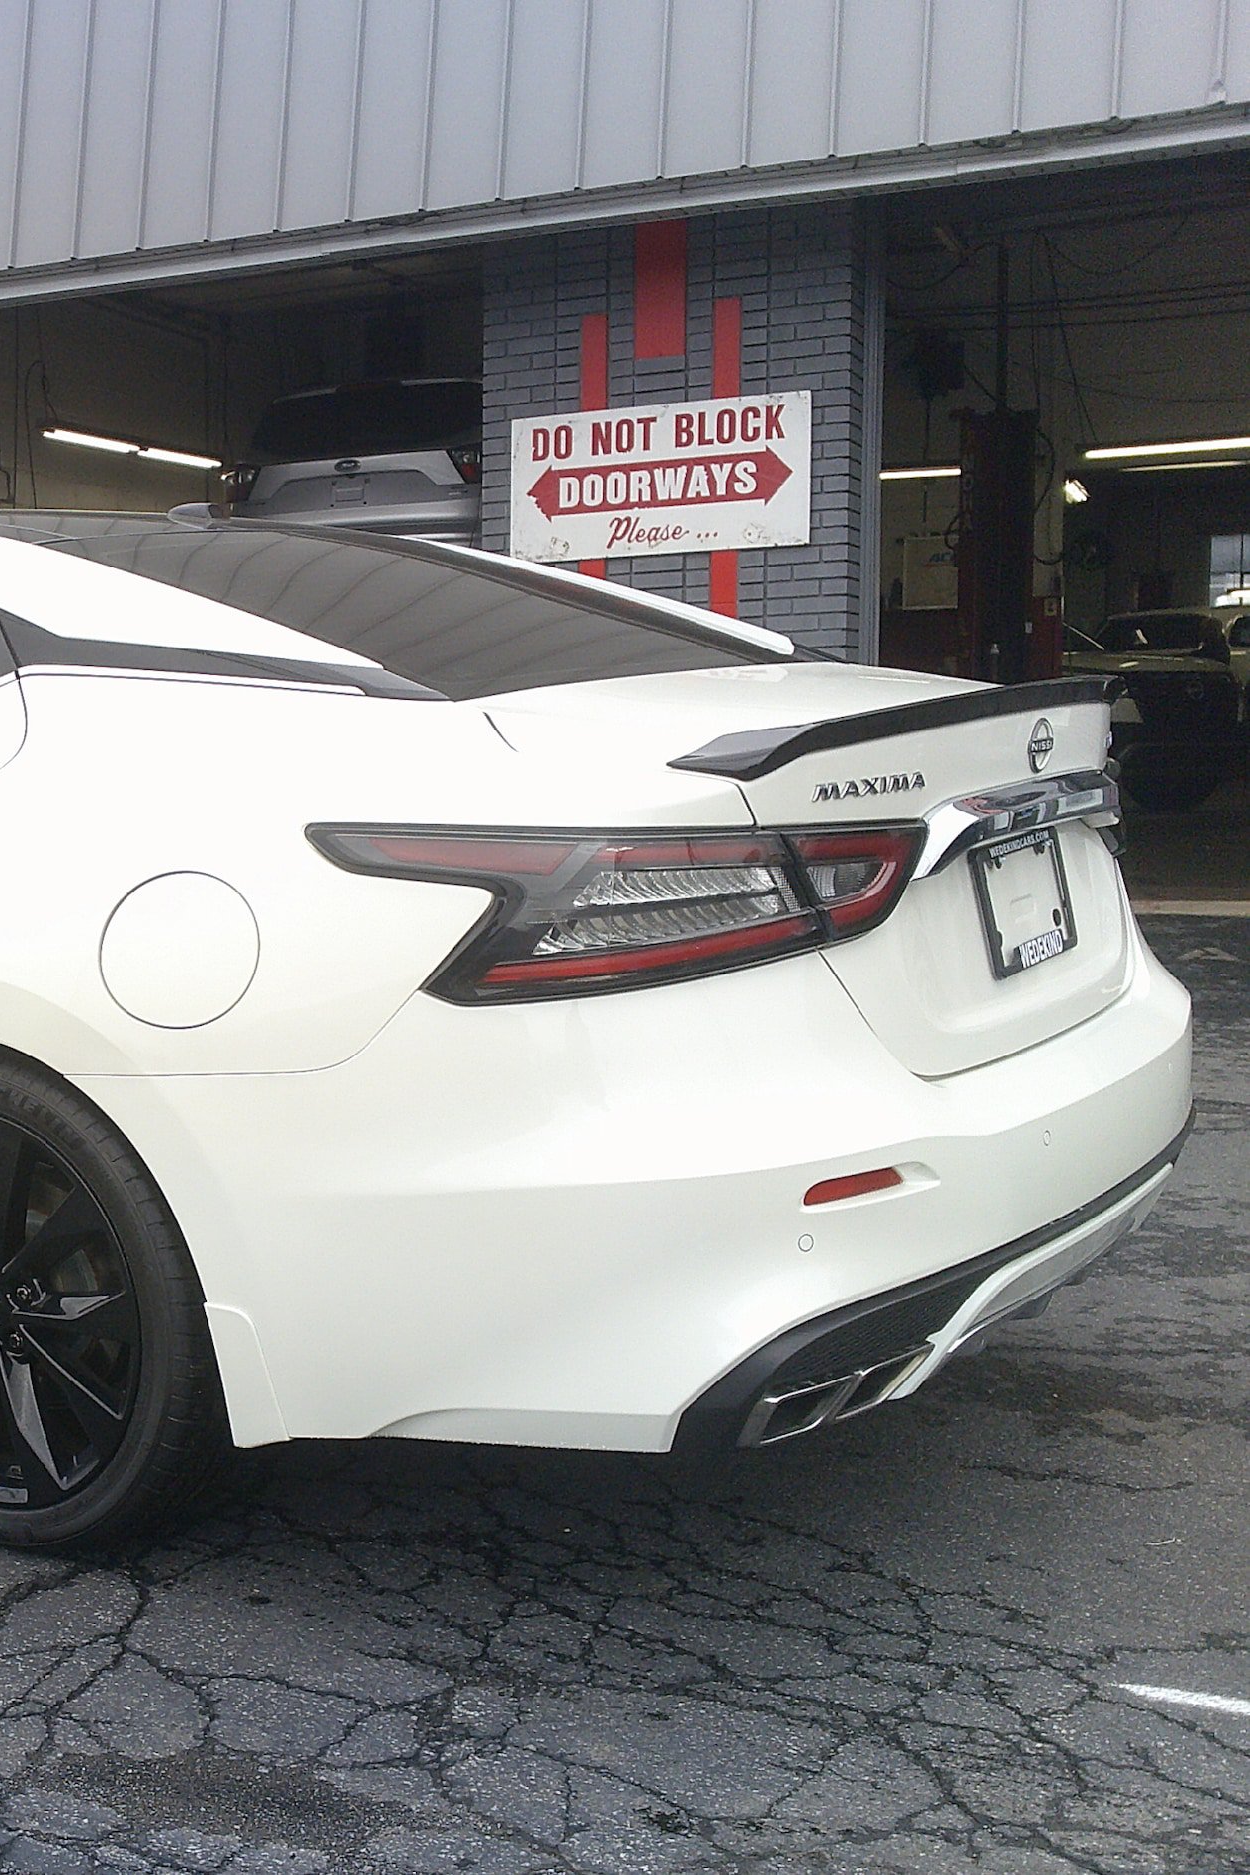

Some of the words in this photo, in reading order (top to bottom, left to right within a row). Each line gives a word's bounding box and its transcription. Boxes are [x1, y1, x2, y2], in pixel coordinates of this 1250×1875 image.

[532, 425, 573, 462] DO
[591, 416, 657, 456] NOT
[674, 403, 786, 448] BLOCK
[558, 460, 757, 509] DOORWAYS
[811, 771, 926, 803] MAXIMA
[988, 830, 1050, 858] WEDEKINDCARS.COM
[1018, 930, 1064, 969] WEDEKIND
